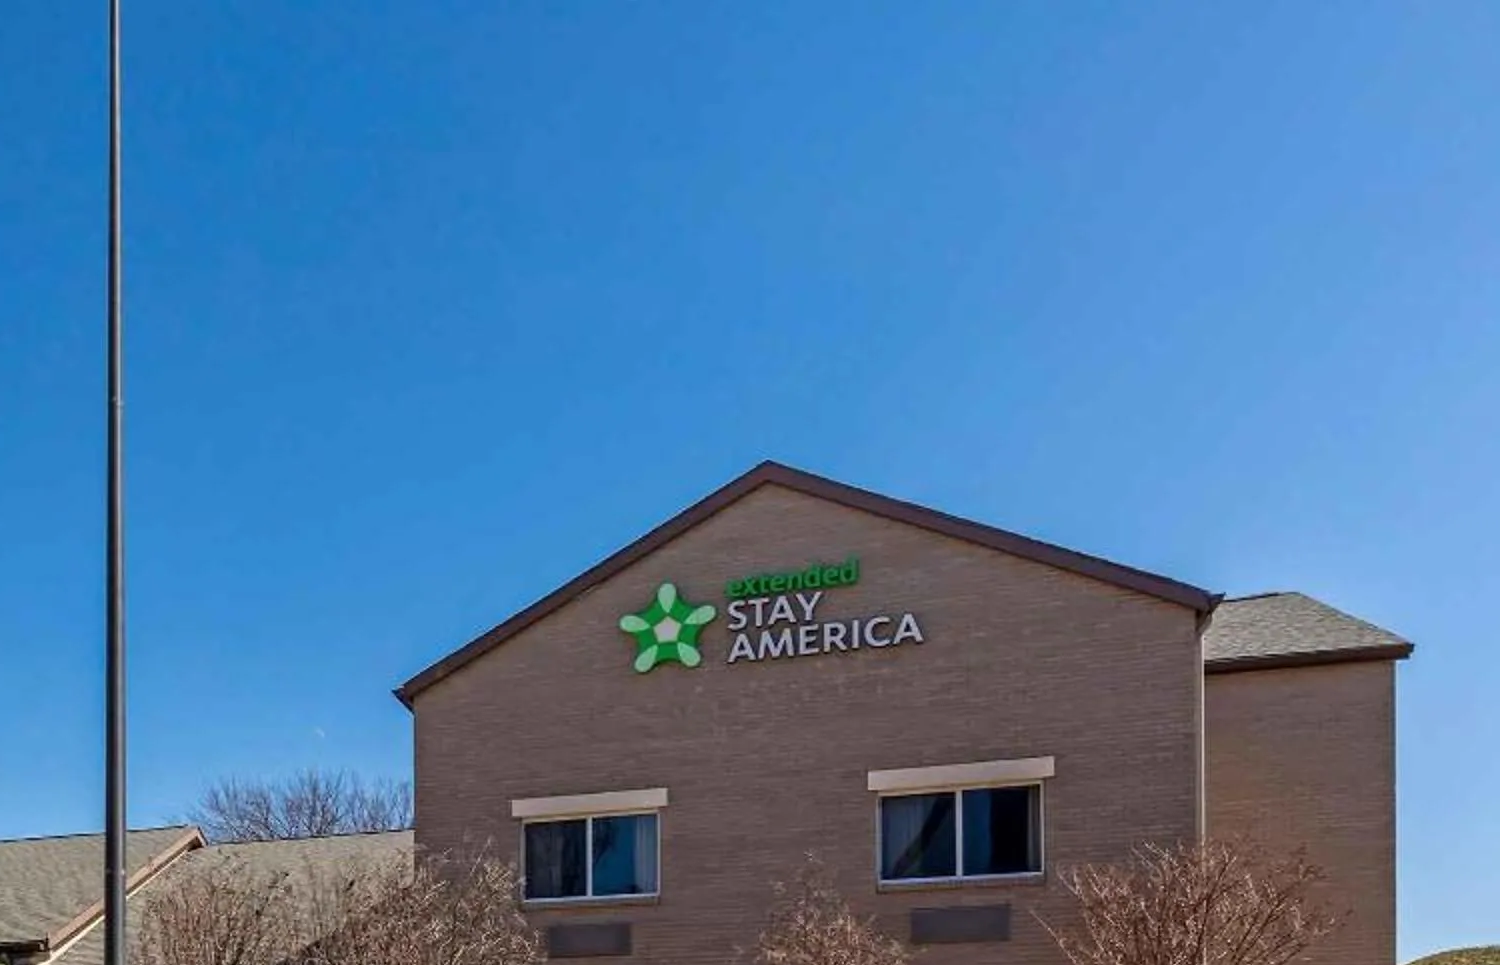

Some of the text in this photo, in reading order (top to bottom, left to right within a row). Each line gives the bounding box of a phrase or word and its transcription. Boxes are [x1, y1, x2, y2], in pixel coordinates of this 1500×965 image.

[726, 556, 859, 598] extended
[726, 591, 823, 631] STAY
[726, 613, 924, 664] AMERICA
